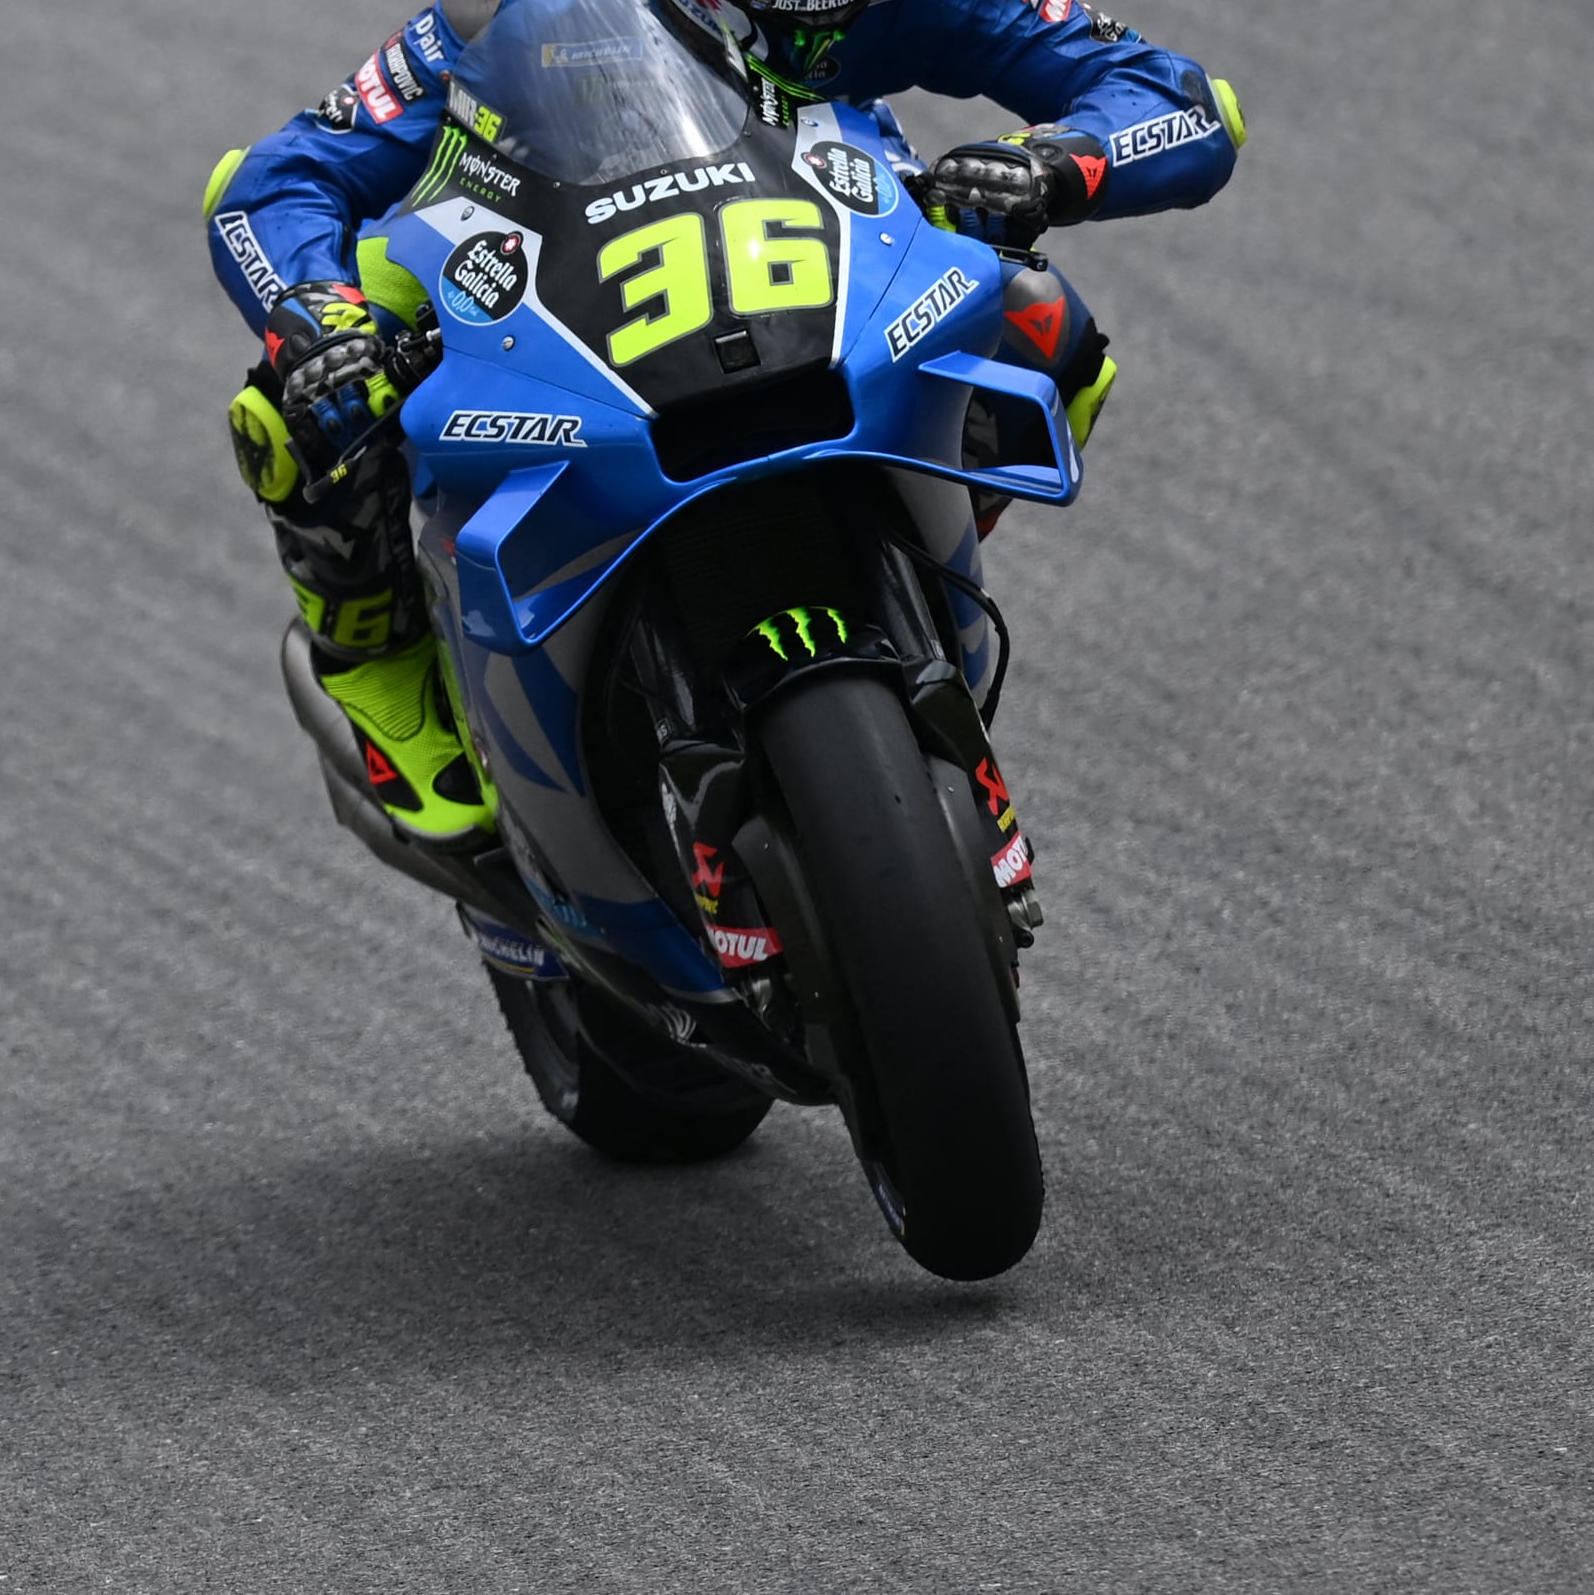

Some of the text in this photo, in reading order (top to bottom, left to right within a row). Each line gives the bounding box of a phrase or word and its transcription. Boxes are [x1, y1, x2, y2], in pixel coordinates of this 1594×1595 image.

[1112, 108, 1220, 165] ECSTAR
[459, 177, 502, 203] ENERGY
[585, 162, 756, 224] SUZUKI
[827, 147, 851, 197] Estrella
[454, 259, 500, 309] Galicia
[467, 239, 517, 292] Estrella
[597, 198, 834, 367] 36
[885, 268, 978, 362] ECSTAR
[440, 411, 587, 447] ECSTAR
[329, 463, 348, 484] 36
[992, 835, 1028, 888] MOT
